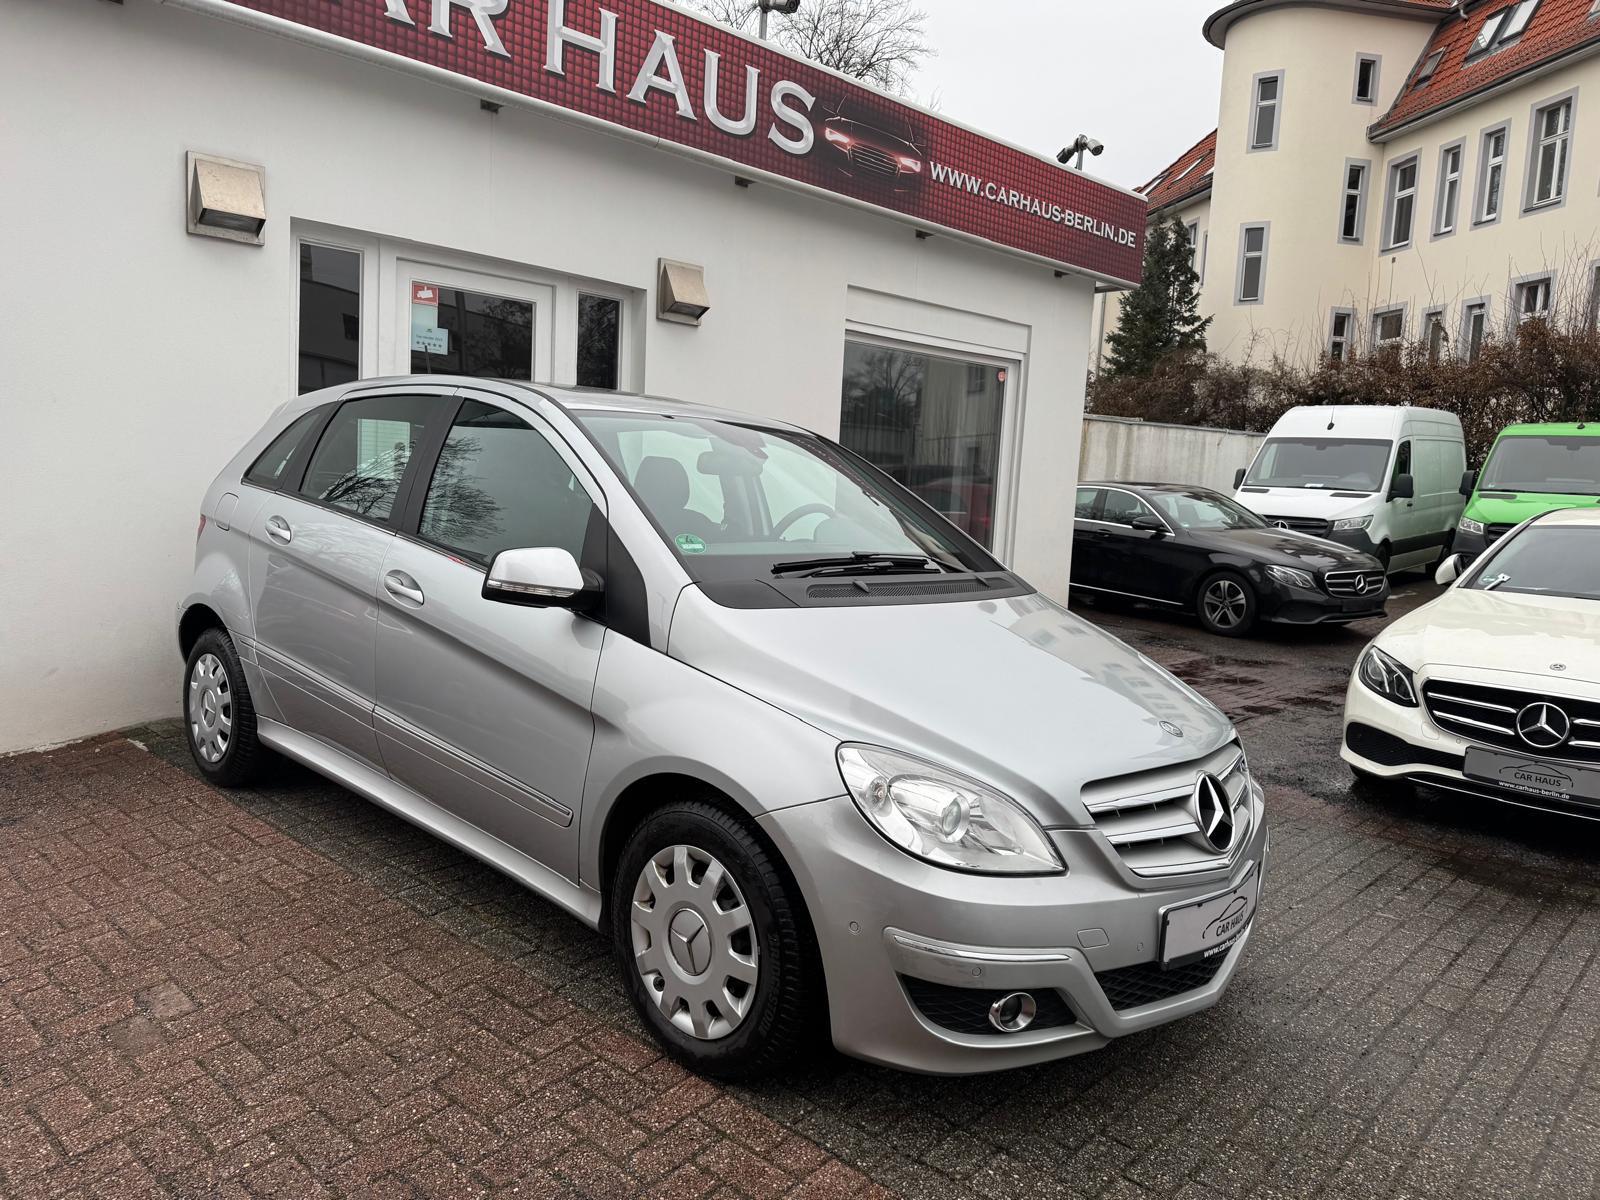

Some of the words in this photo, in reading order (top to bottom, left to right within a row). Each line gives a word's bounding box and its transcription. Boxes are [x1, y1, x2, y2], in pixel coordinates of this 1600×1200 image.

[543, 0, 816, 155] HAUS
[930, 161, 1136, 249] WWW.CARHAUS-BERLIN.DE
[1514, 771, 1533, 782] CAR
[1535, 774, 1561, 787] HAUS
[1499, 781, 1570, 799] www.carhaus-berlin.de
[1216, 921, 1230, 937] CAR
